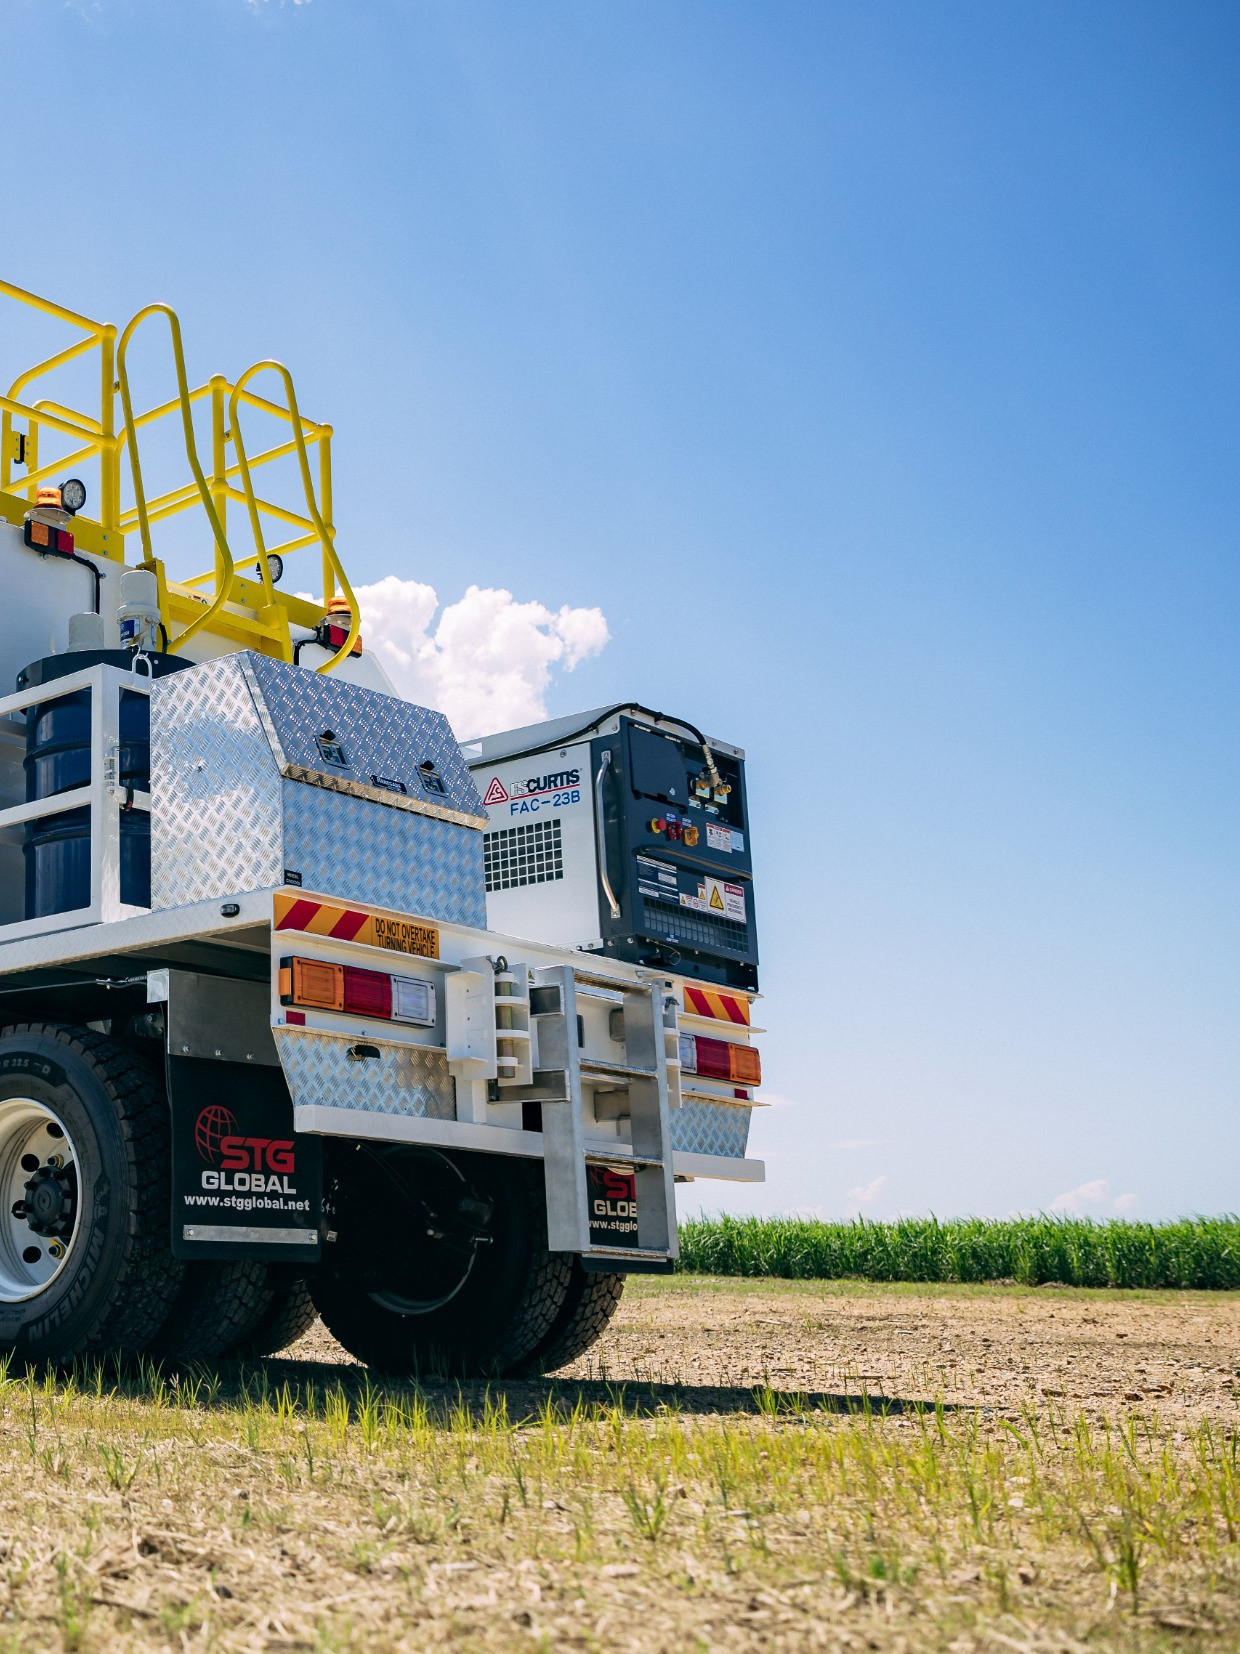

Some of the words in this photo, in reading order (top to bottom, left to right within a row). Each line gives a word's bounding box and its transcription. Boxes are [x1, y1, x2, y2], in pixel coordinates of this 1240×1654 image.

[510, 790, 581, 816] FAC-23B
[375, 918, 385, 934] DO
[387, 921, 400, 937] NOT
[402, 924, 435, 945] OVERTAKE
[377, 934, 407, 953] TURNING
[408, 940, 435, 958] VEHICLE
[220, 1136, 296, 1173] STG
[201, 1170, 297, 1195] GLOBAL
[184, 1194, 310, 1211] www.stgglobal.net
[589, 1219, 638, 1233] ww.stgglo
[28, 1226, 105, 1343] MICHELIN
